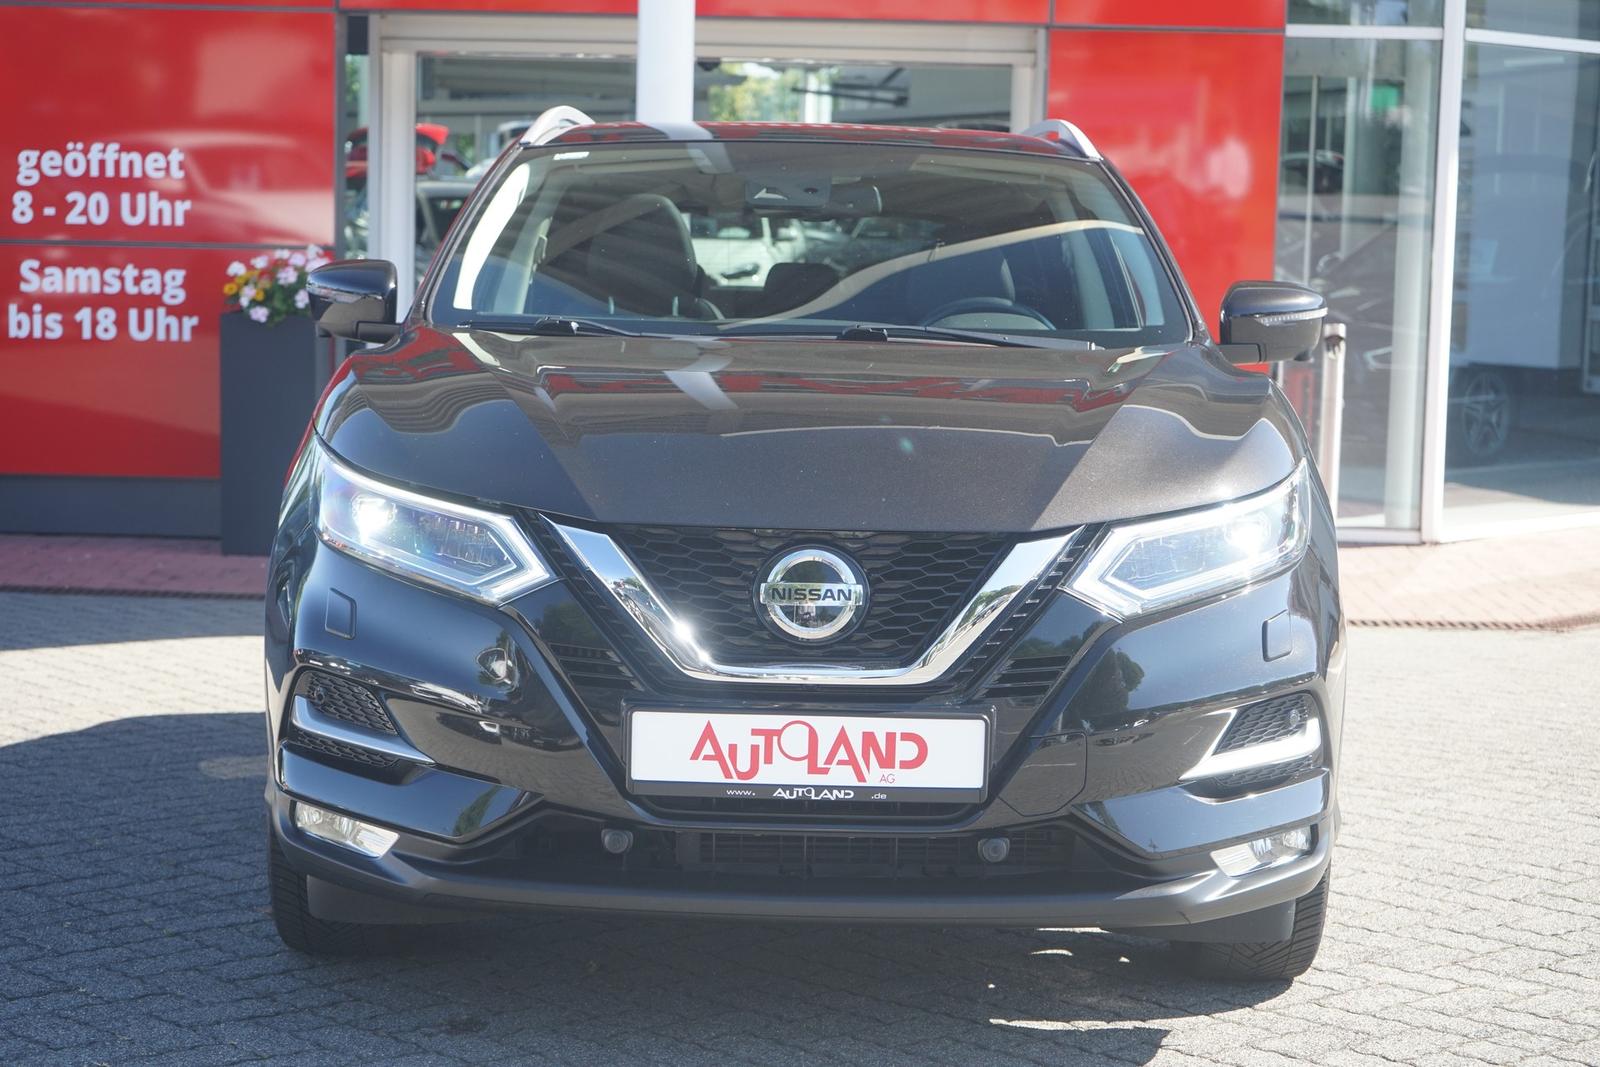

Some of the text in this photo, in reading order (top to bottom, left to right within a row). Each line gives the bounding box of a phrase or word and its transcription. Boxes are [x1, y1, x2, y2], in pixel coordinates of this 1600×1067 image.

[16, 142, 184, 186] geöffnet
[11, 190, 34, 224] 8
[65, 191, 109, 225] 20
[120, 191, 192, 226] Uhr
[19, 259, 186, 305] Samstag
[8, 304, 199, 342] bis 18 Uhr
[771, 588, 852, 601] NISSAN
[879, 774, 896, 784] AG
